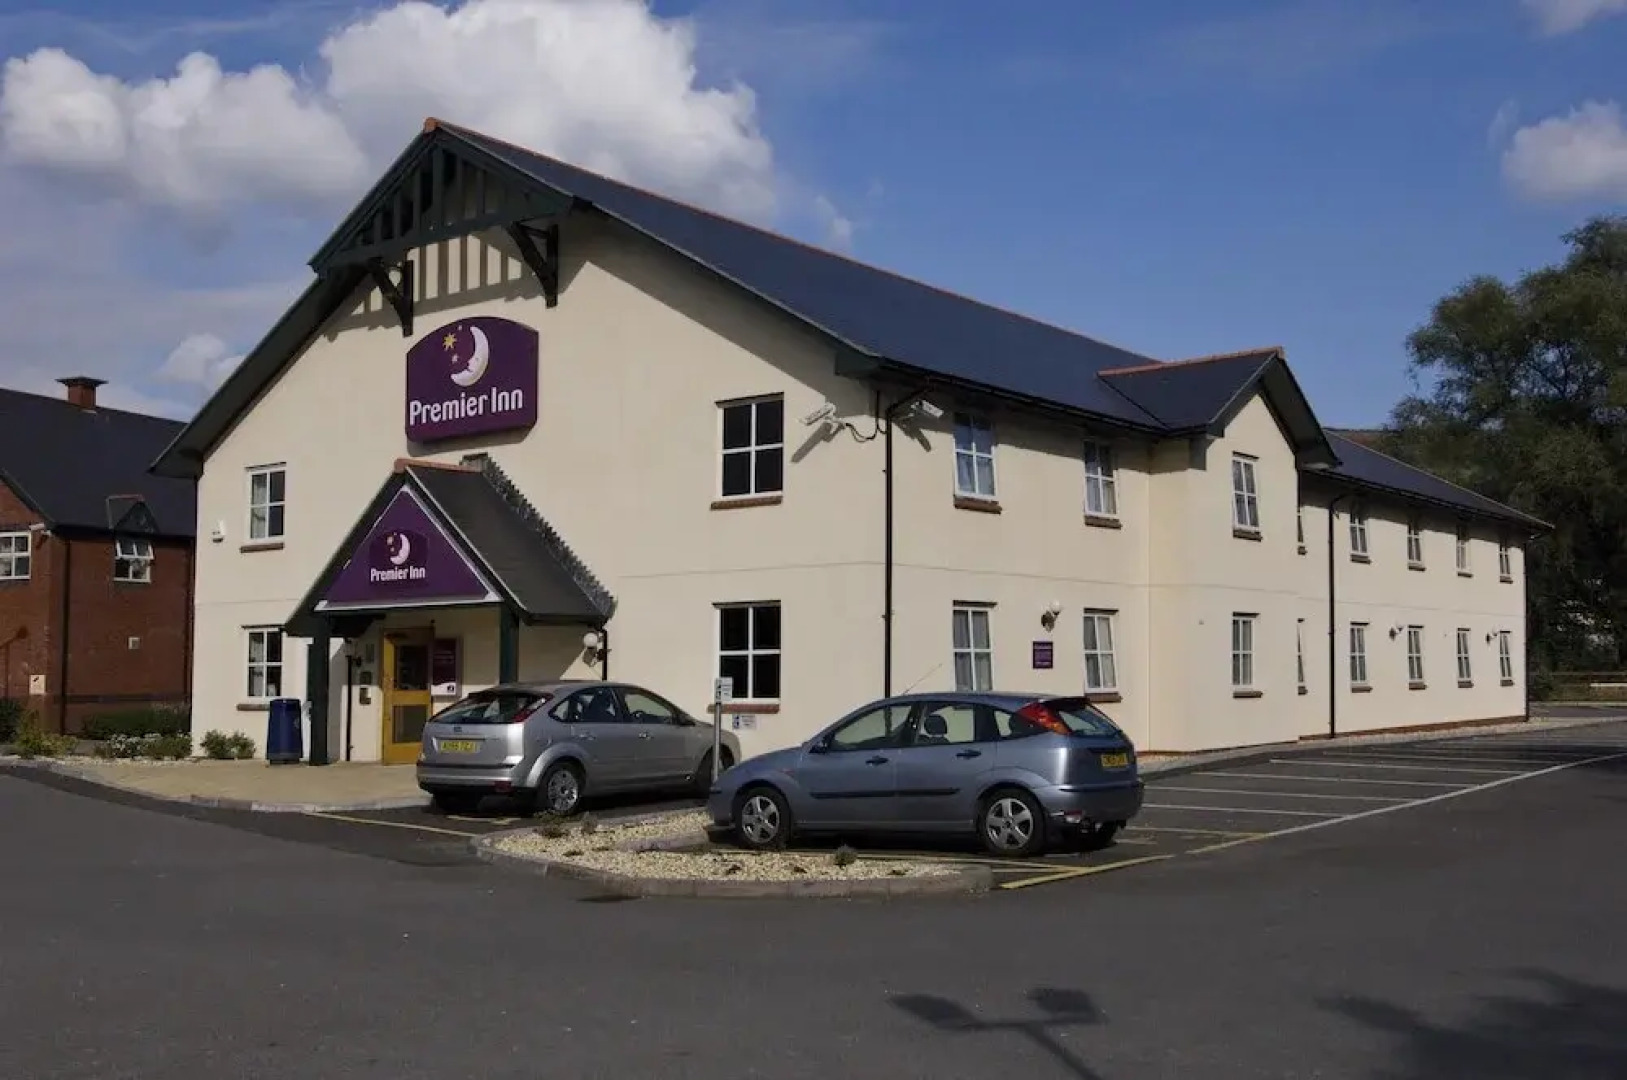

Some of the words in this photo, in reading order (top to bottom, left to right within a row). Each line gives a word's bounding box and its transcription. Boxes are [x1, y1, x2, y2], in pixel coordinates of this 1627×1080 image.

[409, 393, 488, 426] Premier
[491, 387, 523, 413] Inn
[370, 567, 409, 582] Premier
[410, 566, 426, 580] Inn
